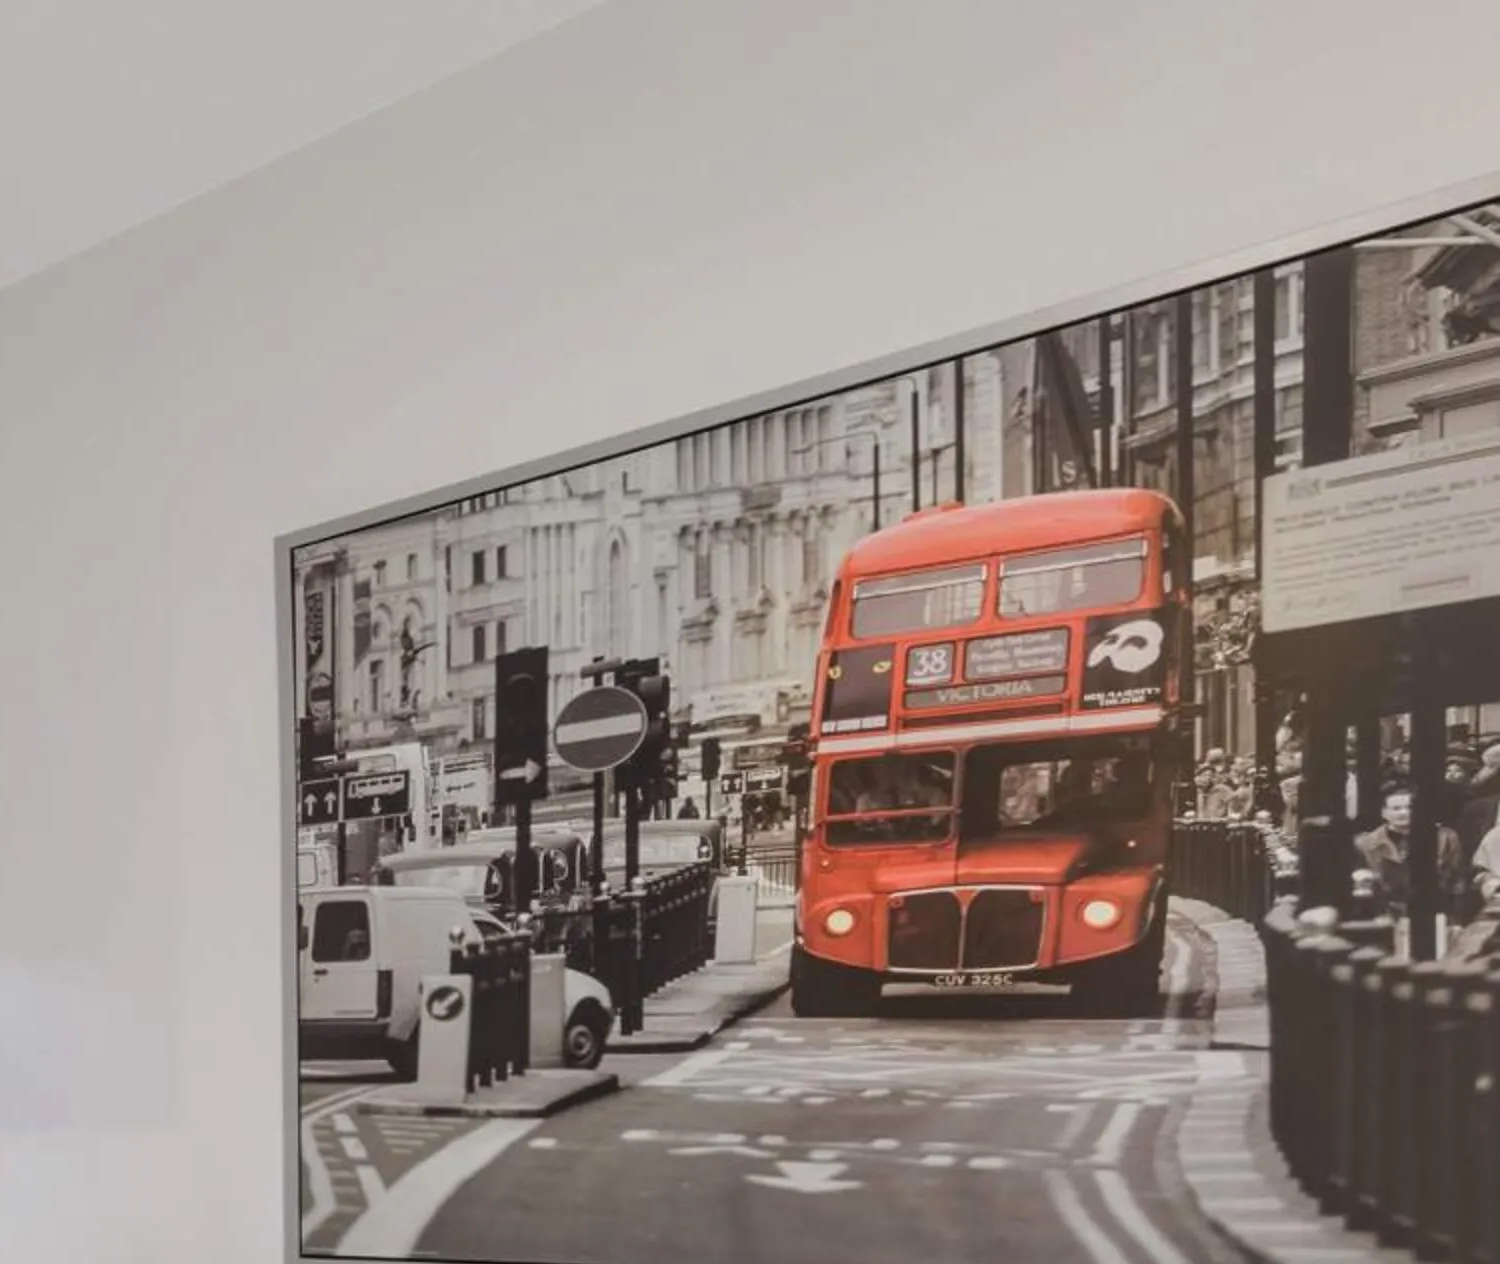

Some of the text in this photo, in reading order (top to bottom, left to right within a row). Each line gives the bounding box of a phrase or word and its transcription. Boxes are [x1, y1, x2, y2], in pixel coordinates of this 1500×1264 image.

[913, 648, 948, 677] 38
[936, 679, 1033, 703] VICTORIA
[934, 975, 966, 986] CUV
